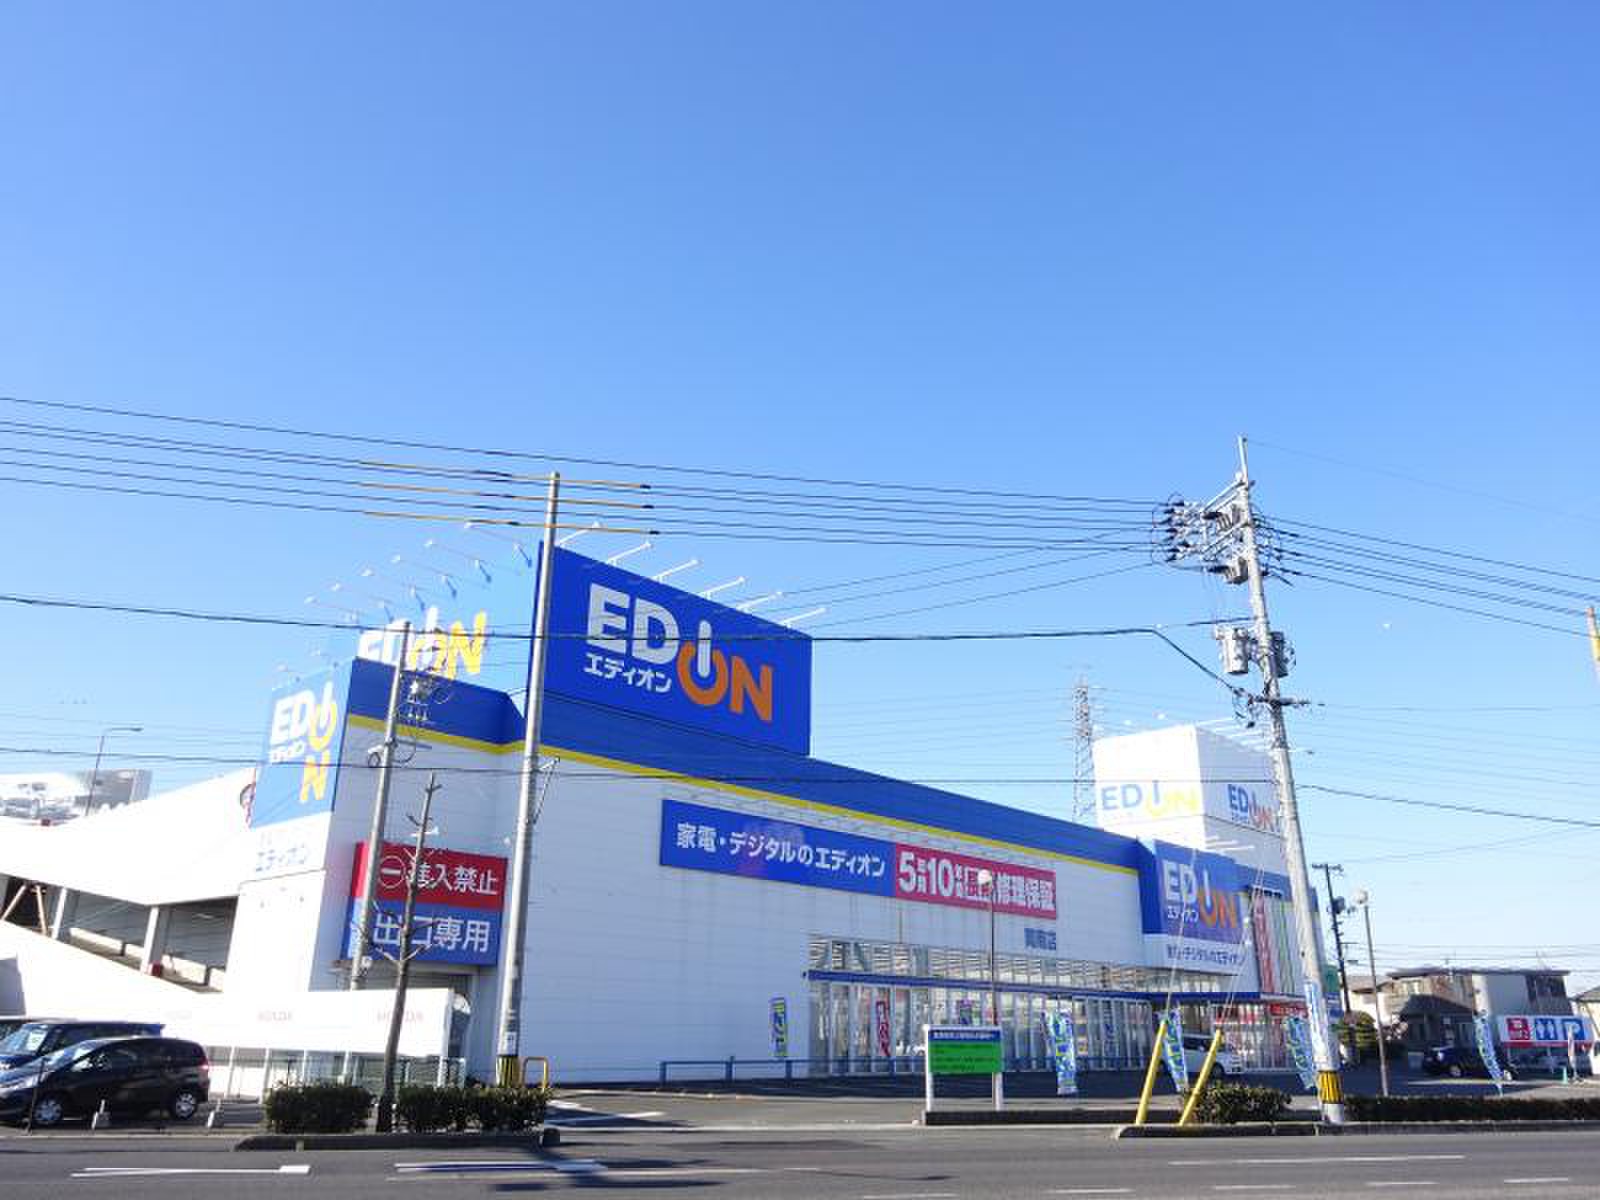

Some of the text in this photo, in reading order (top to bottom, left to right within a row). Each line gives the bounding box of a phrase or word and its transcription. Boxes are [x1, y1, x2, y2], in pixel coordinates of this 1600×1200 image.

[584, 652, 672, 692] エディオン
[586, 582, 774, 722] EDION
[676, 821, 887, 878] 家電・デジタルのエディオン
[407, 860, 498, 896] 進入禁止
[1163, 859, 1240, 930] EDION
[373, 912, 491, 952] 出口専用
